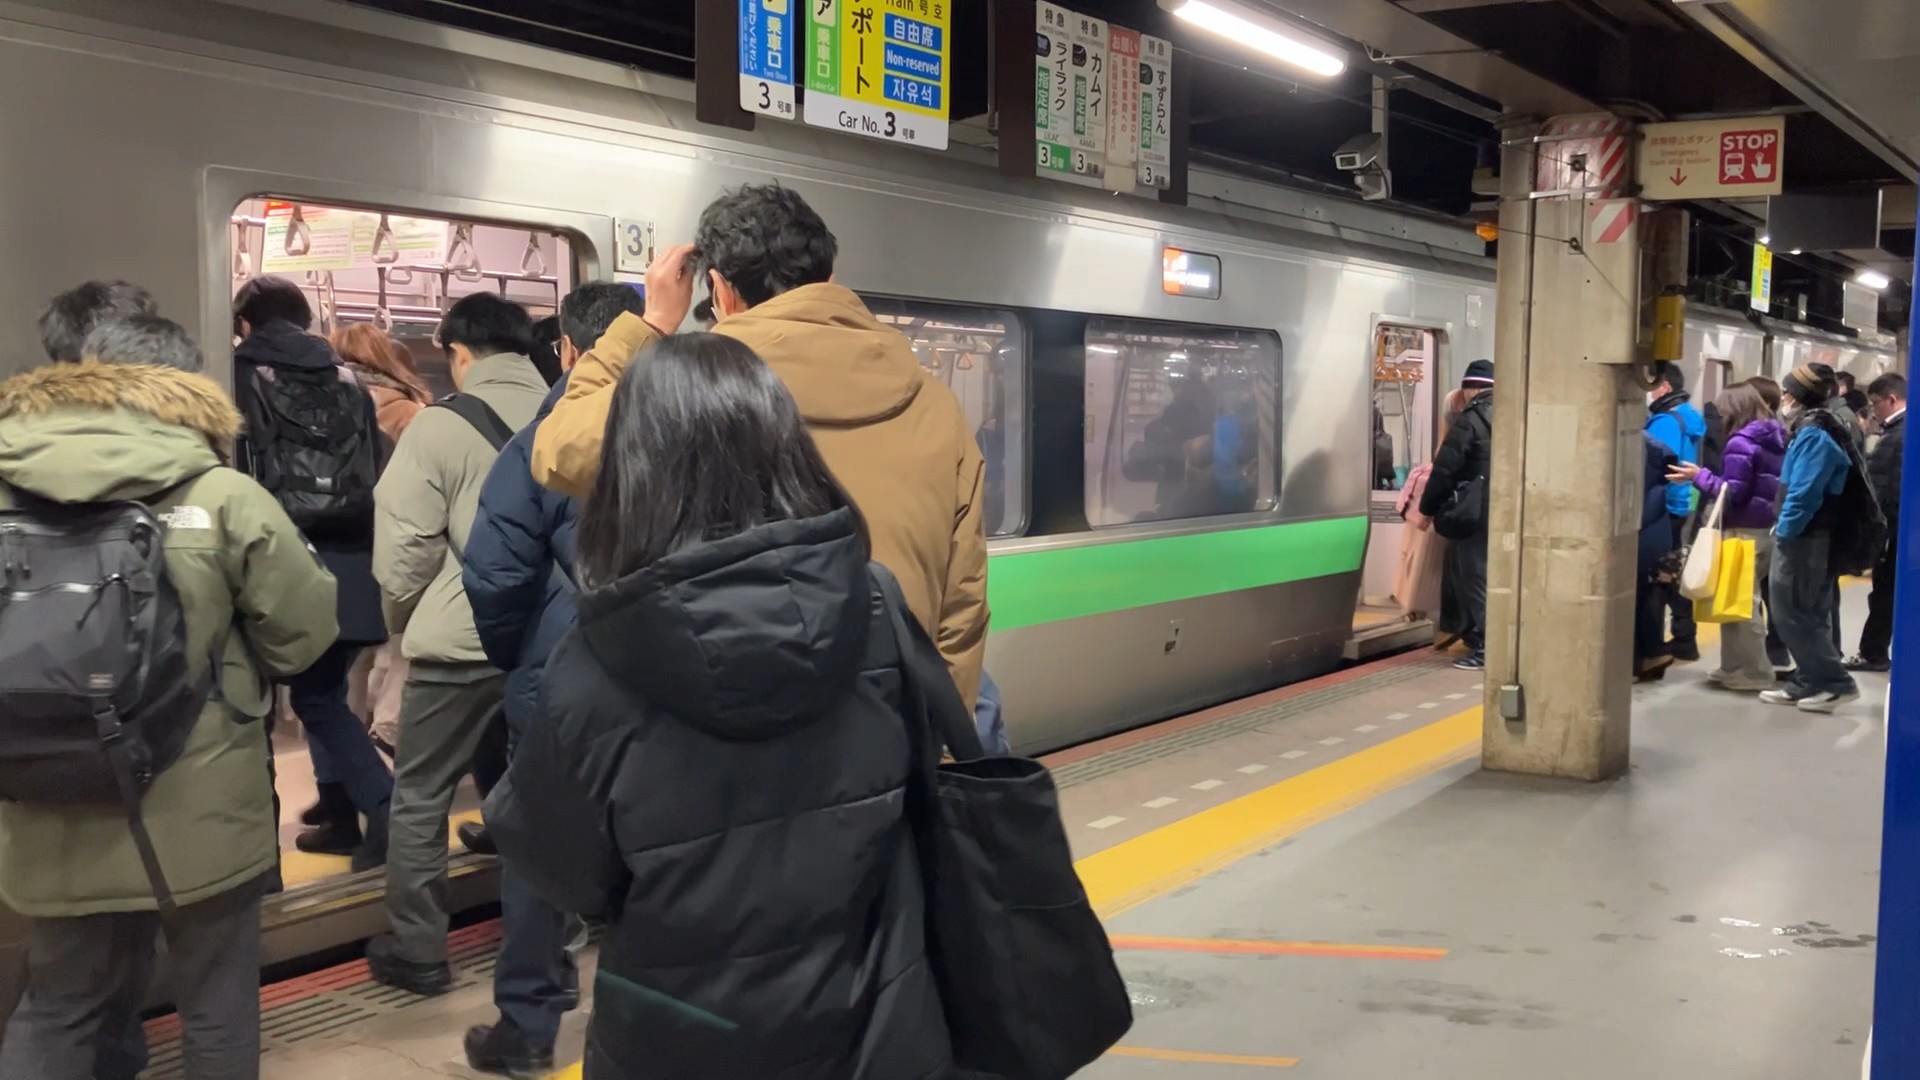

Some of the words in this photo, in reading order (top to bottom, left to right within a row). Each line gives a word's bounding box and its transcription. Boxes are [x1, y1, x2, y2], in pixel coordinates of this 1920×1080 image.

[893, 18, 934, 47] 自由席
[1045, 8, 1065, 28] 特急
[1081, 19, 1099, 37] 特急
[767, 15, 782, 69] 乗車口
[816, 27, 831, 78] 乗車口
[851, 0, 873, 95] ポート
[886, 48, 940, 76] Non-reserved
[1055, 41, 1068, 111] ライラック
[759, 82, 771, 110] 3
[777, 100, 793, 113] 号車
[892, 78, 933, 106] 자유석
[1091, 53, 1103, 117] カムイ
[1156, 70, 1168, 135] すずらん
[839, 110, 857, 128] Car
[862, 115, 880, 134] No.
[884, 111, 897, 138] 3
[902, 127, 915, 140] 号車
[1040, 146, 1049, 165] 3
[1723, 134, 1776, 151] STOP
[1077, 153, 1085, 172] 3
[1145, 166, 1153, 184] 3
[627, 224, 643, 256] 3
